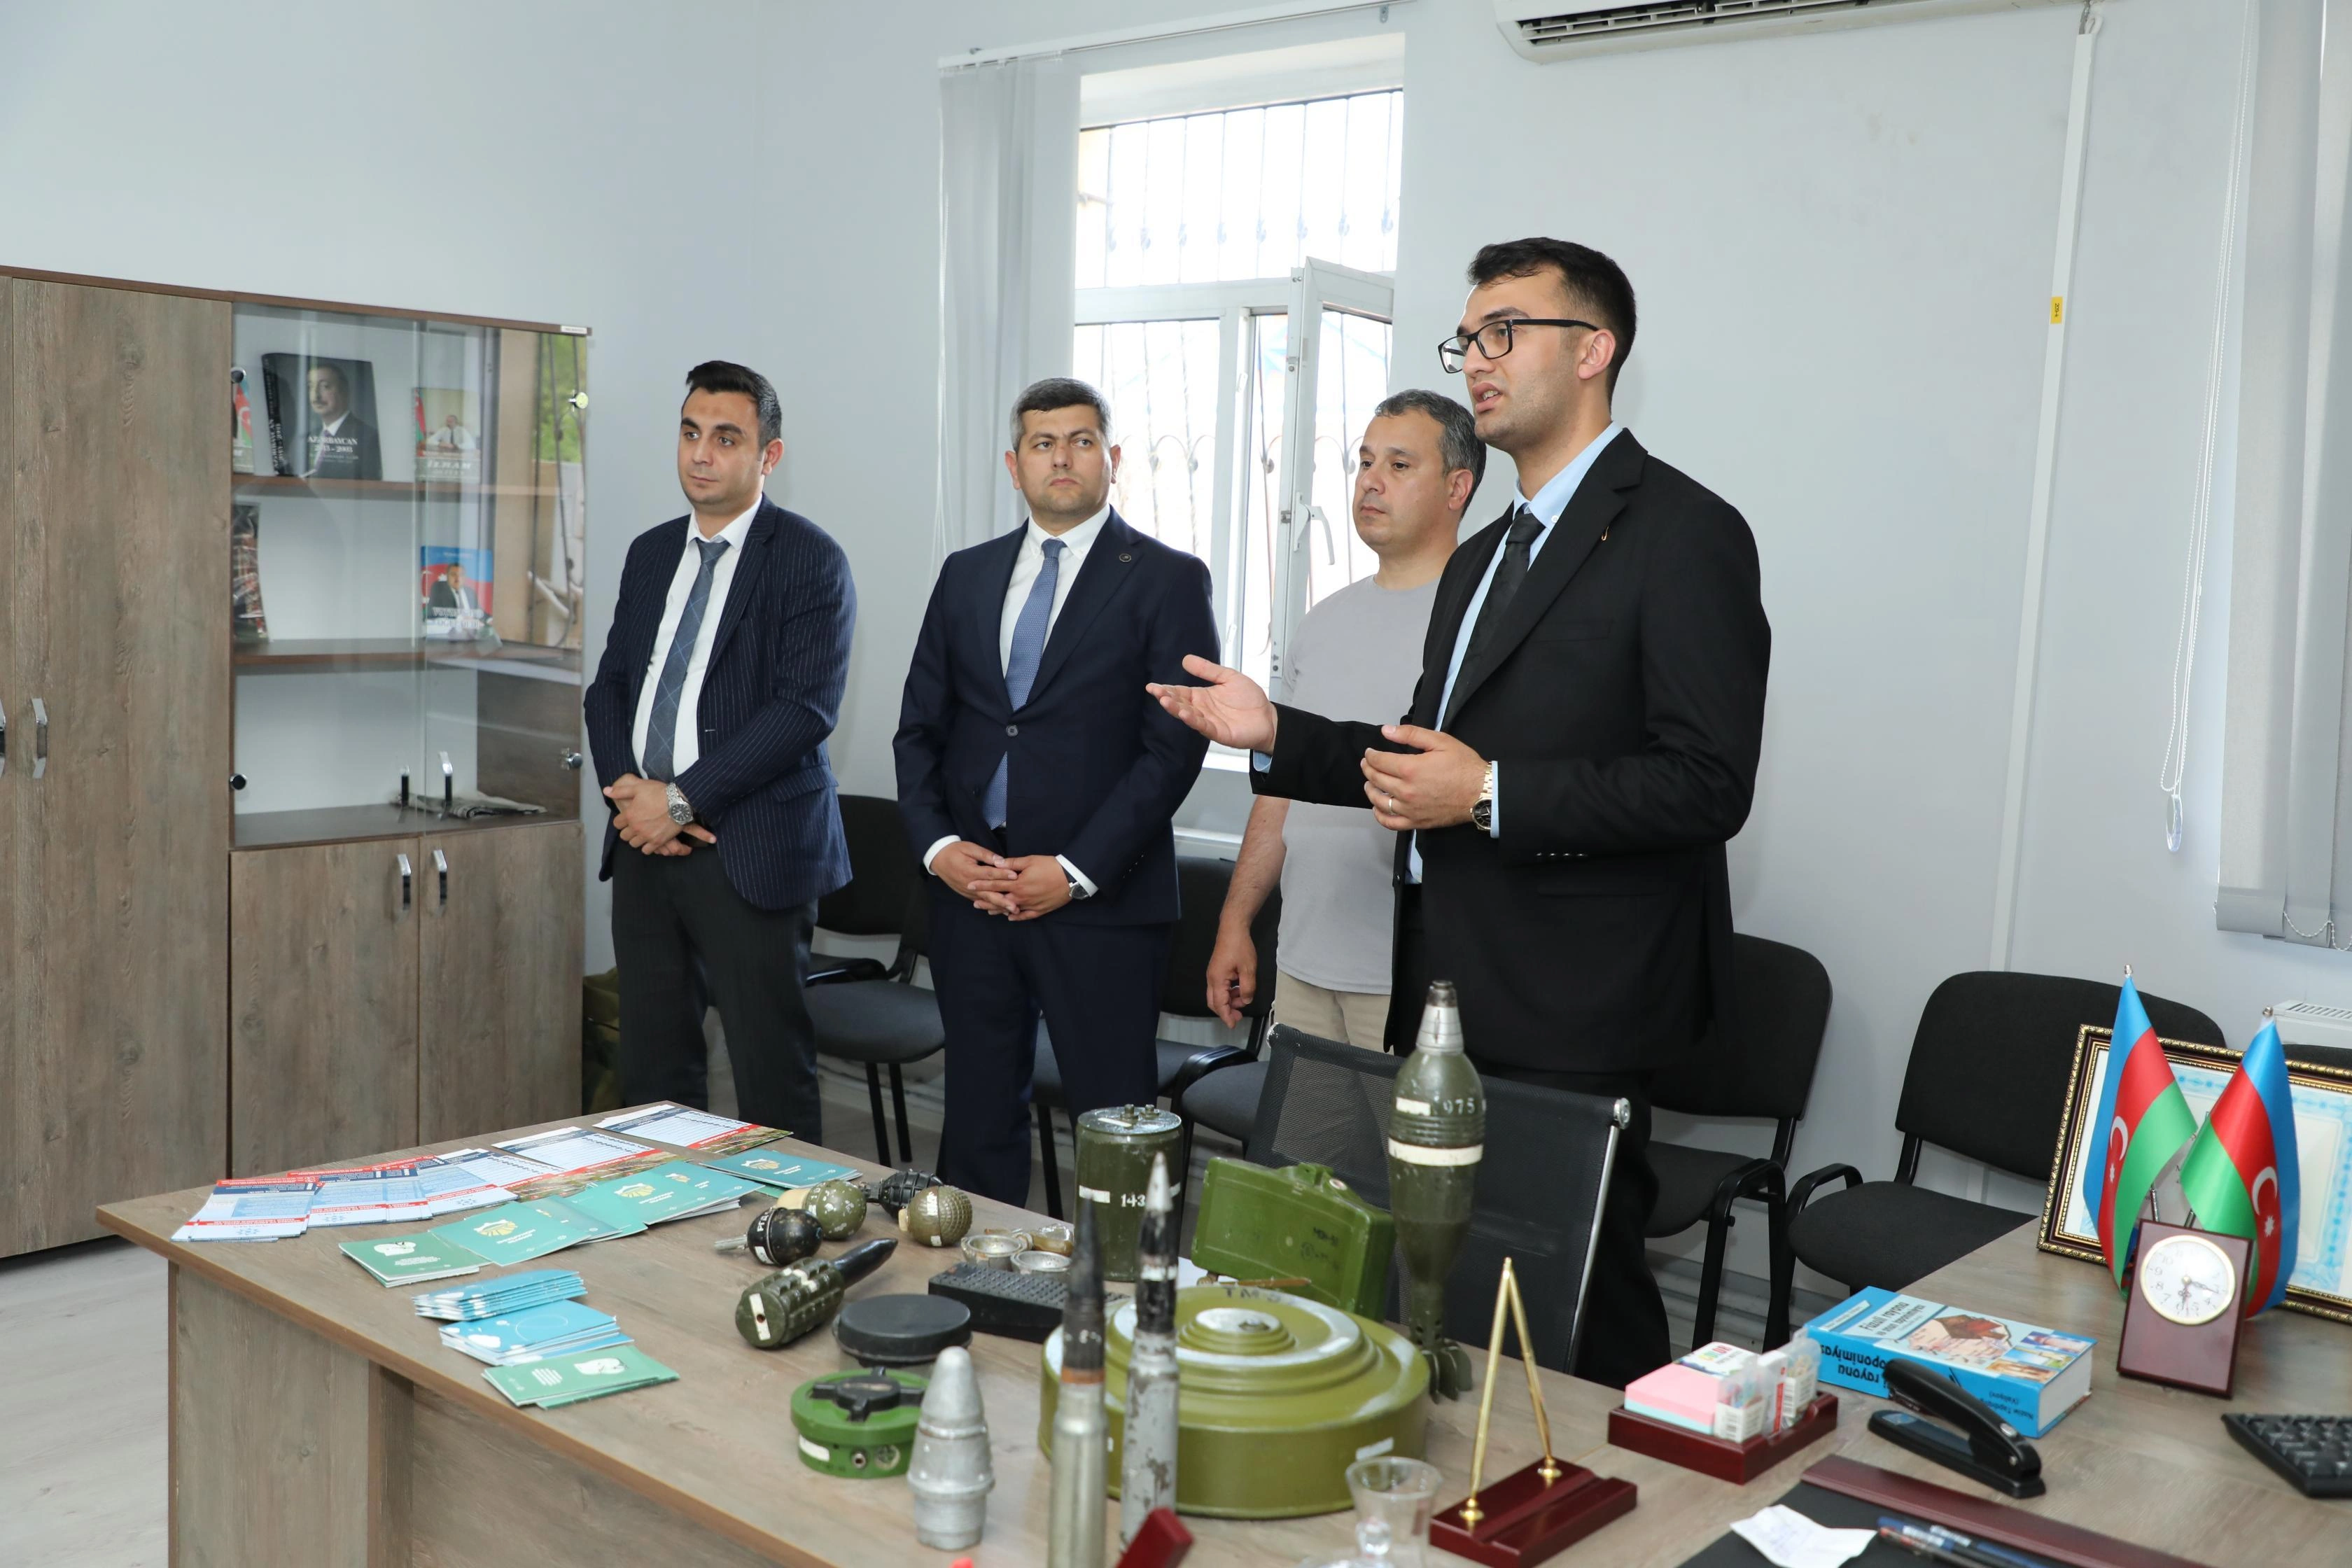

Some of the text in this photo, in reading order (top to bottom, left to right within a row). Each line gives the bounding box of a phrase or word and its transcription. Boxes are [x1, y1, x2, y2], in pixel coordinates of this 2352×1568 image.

[1882, 1301, 1910, 1318] rayonu
[1820, 1344, 1886, 1370] oponimiyas
[1837, 1364, 1879, 1384] rayonu
